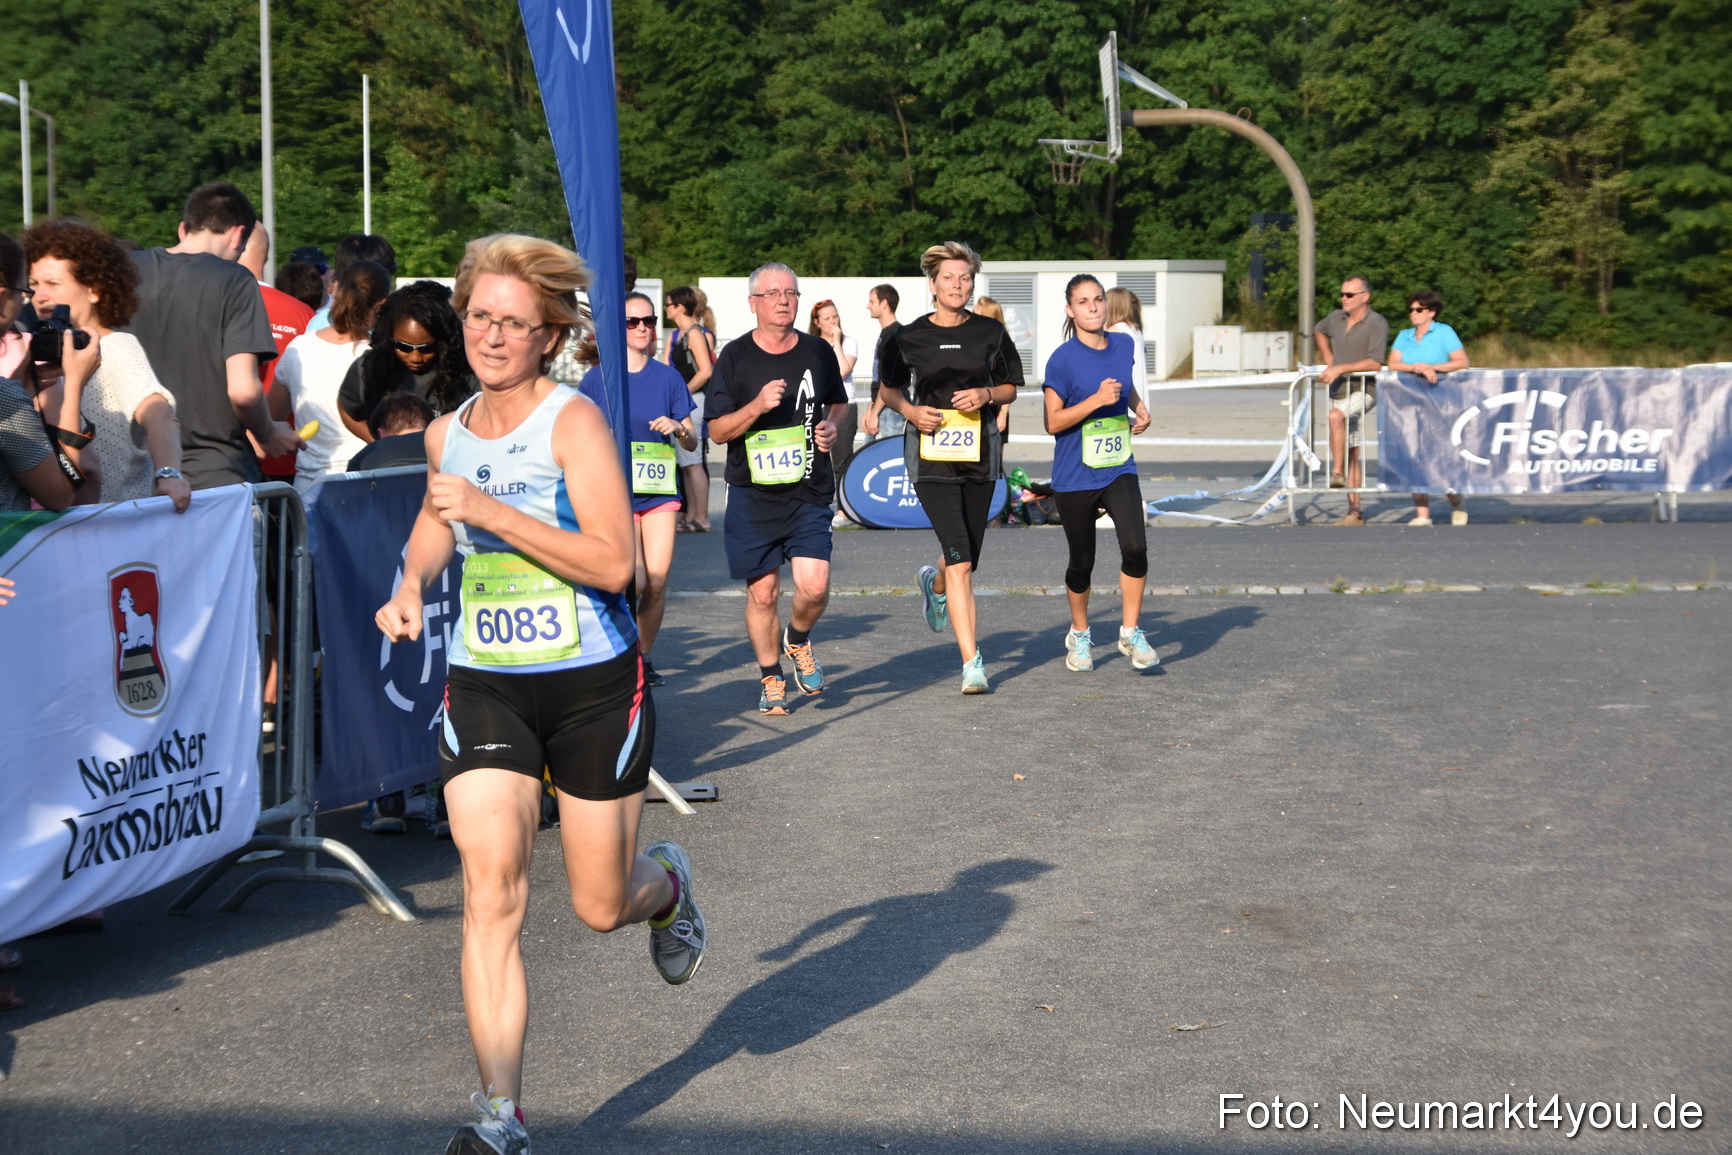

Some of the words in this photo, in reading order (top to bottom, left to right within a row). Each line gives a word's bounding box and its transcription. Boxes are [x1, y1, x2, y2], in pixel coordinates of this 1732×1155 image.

[928, 430, 974, 447] 1228
[1094, 436, 1122, 454] 758
[1490, 420, 1674, 455] Fischer
[59, 453, 81, 480] SONY
[754, 449, 803, 470] 1145
[1507, 458, 1659, 474] AUTOMOBILE
[636, 463, 666, 479] 769
[465, 561, 489, 573] 2013
[476, 605, 562, 644] 6083
[126, 680, 157, 704] 1628
